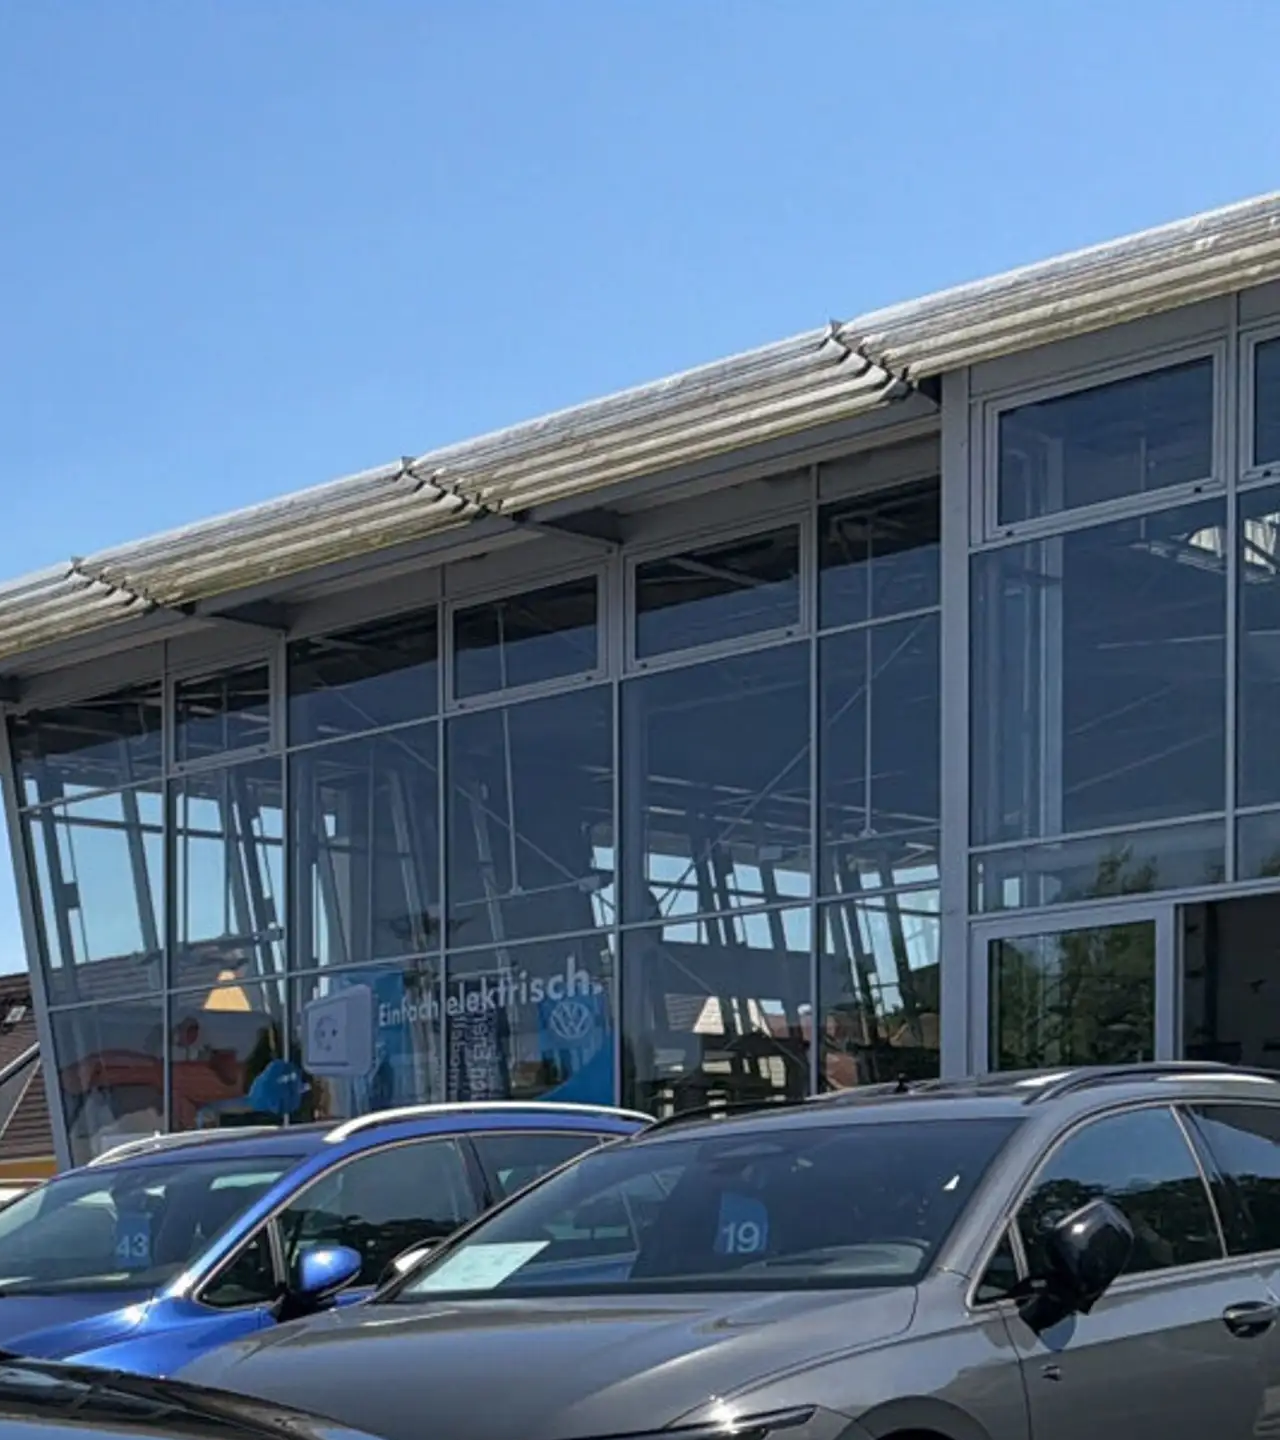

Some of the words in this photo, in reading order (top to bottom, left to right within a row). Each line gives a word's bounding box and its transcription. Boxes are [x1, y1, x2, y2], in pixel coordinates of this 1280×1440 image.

[378, 990, 439, 1027] Einfach
[116, 1231, 149, 1257] 43
[722, 1221, 760, 1253] 19
